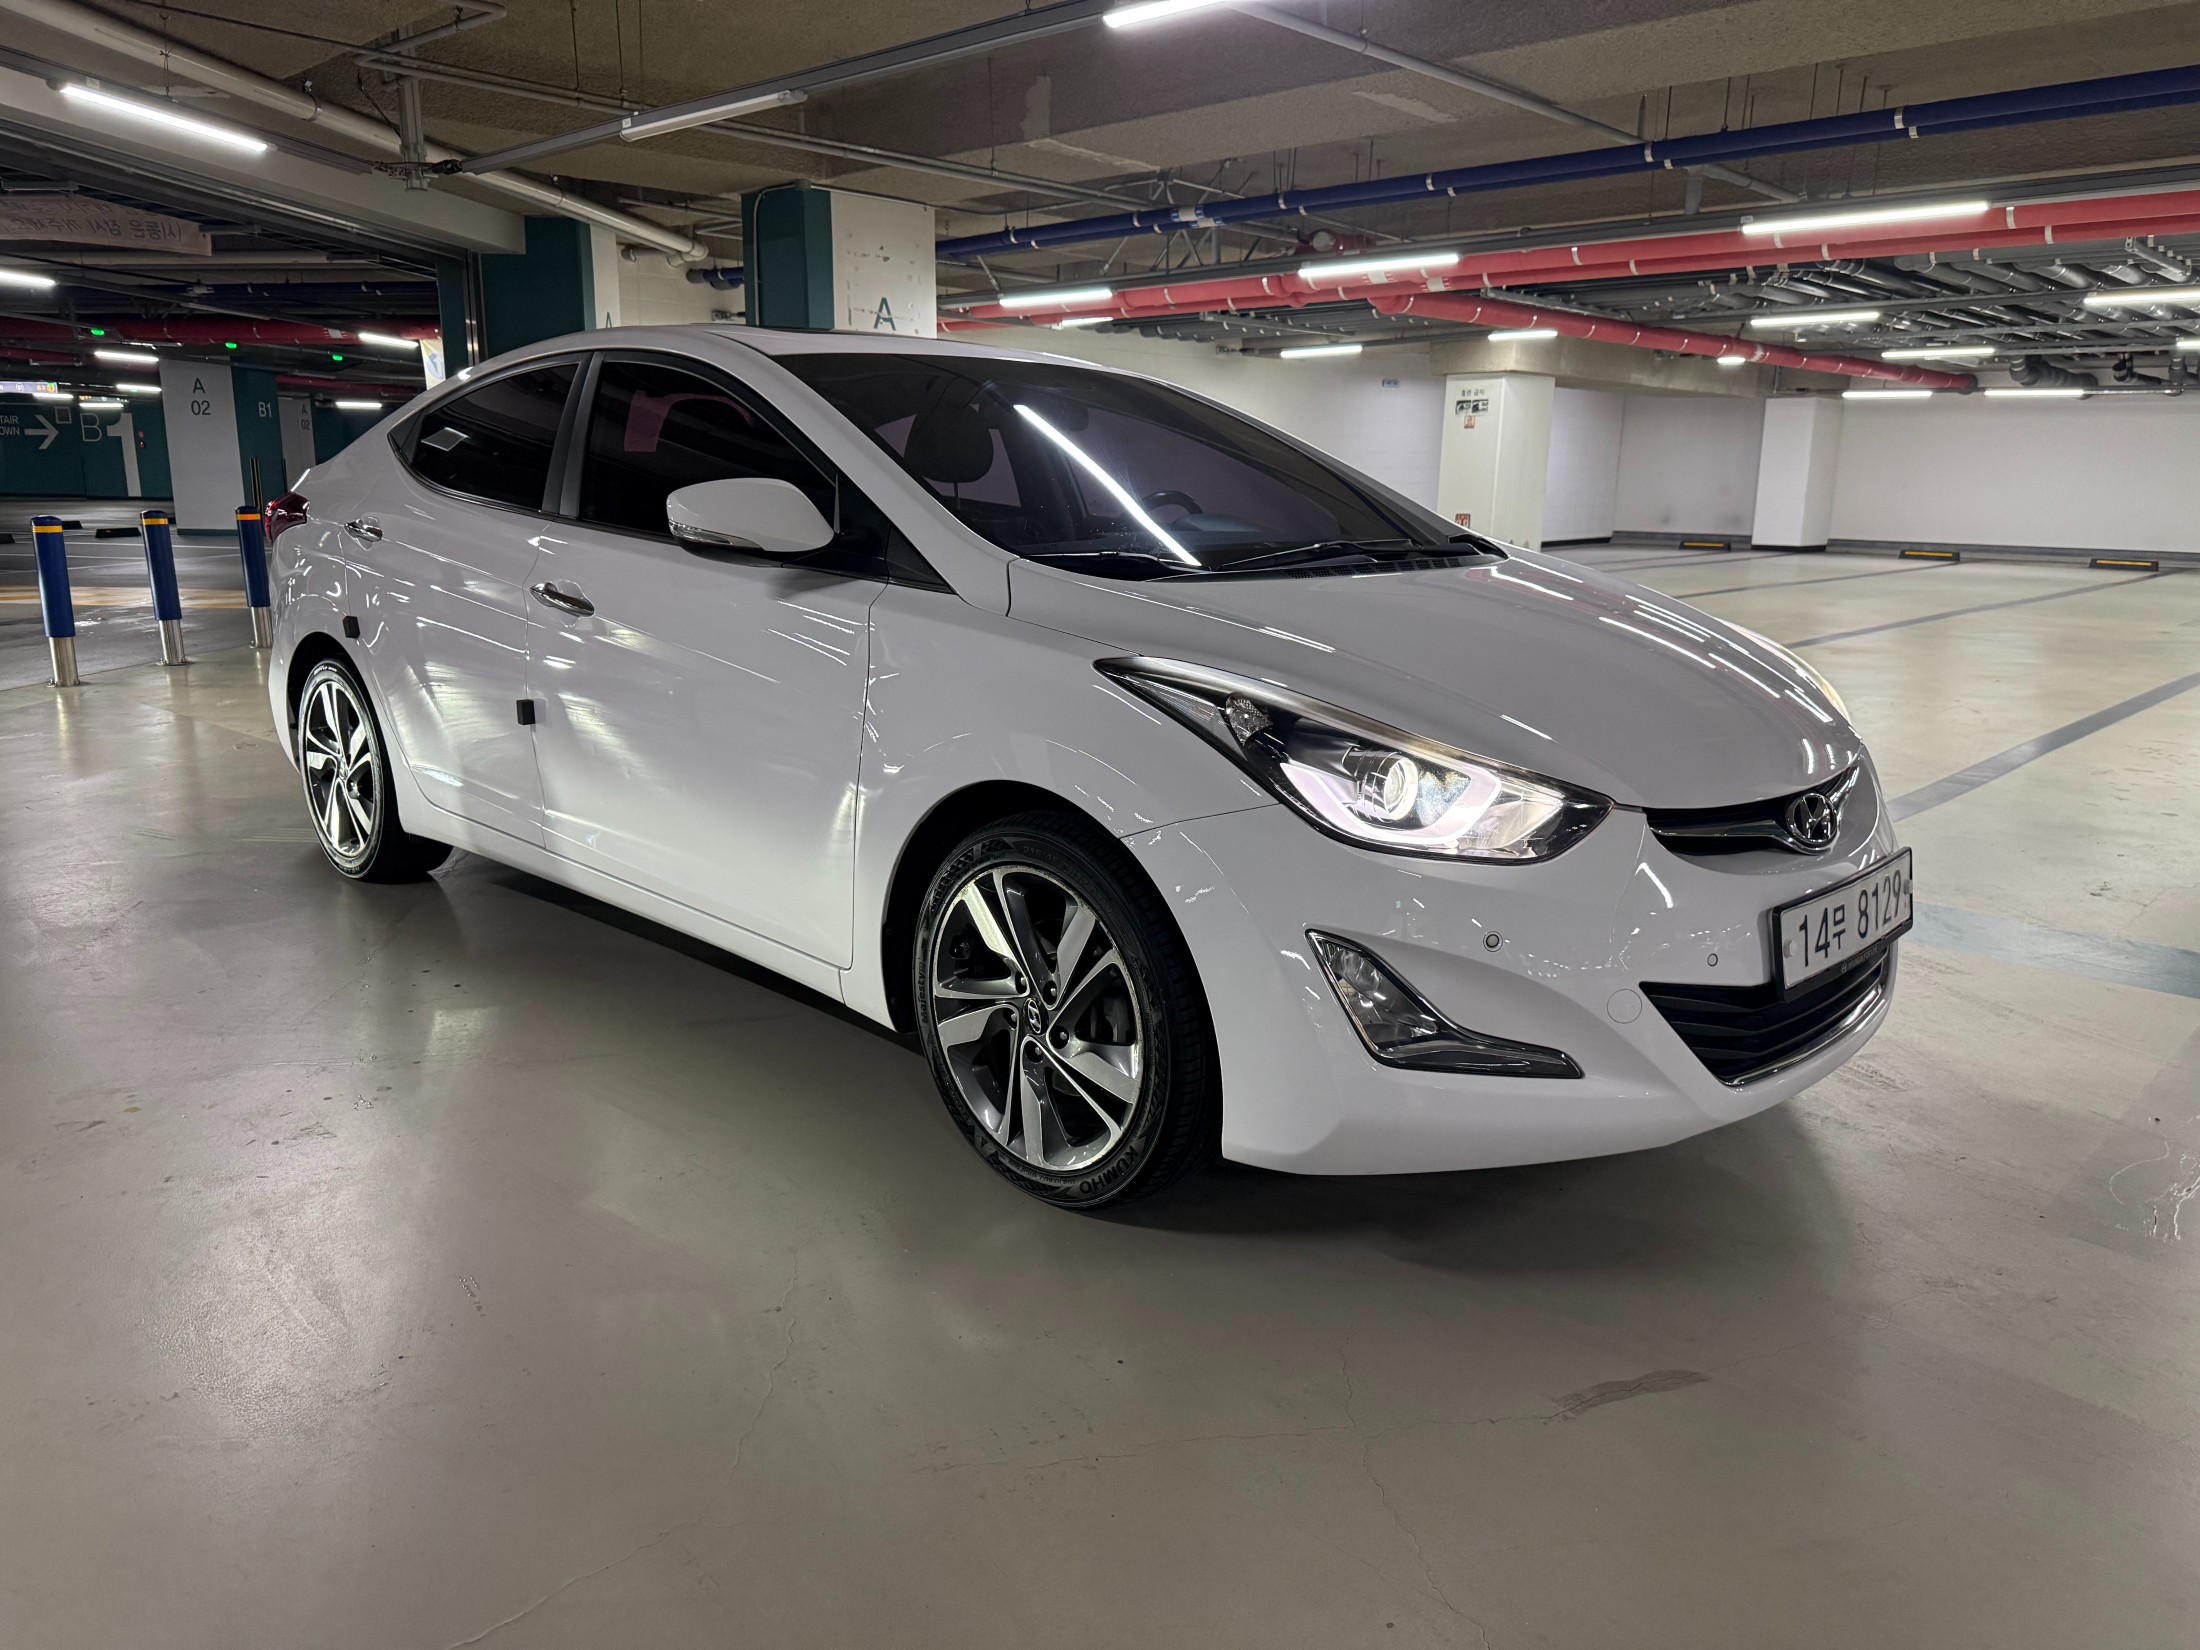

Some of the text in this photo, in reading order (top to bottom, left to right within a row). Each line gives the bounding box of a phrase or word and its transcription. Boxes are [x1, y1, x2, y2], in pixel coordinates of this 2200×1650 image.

[873, 297, 896, 332] A
[193, 378, 206, 394] A
[191, 400, 211, 416] 02
[258, 402, 272, 418] B1
[301, 404, 308, 416] A
[300, 418, 310, 431] 02
[1799, 869, 1901, 967] 14무 8129
[1079, 1144, 1139, 1195] KUMHO
